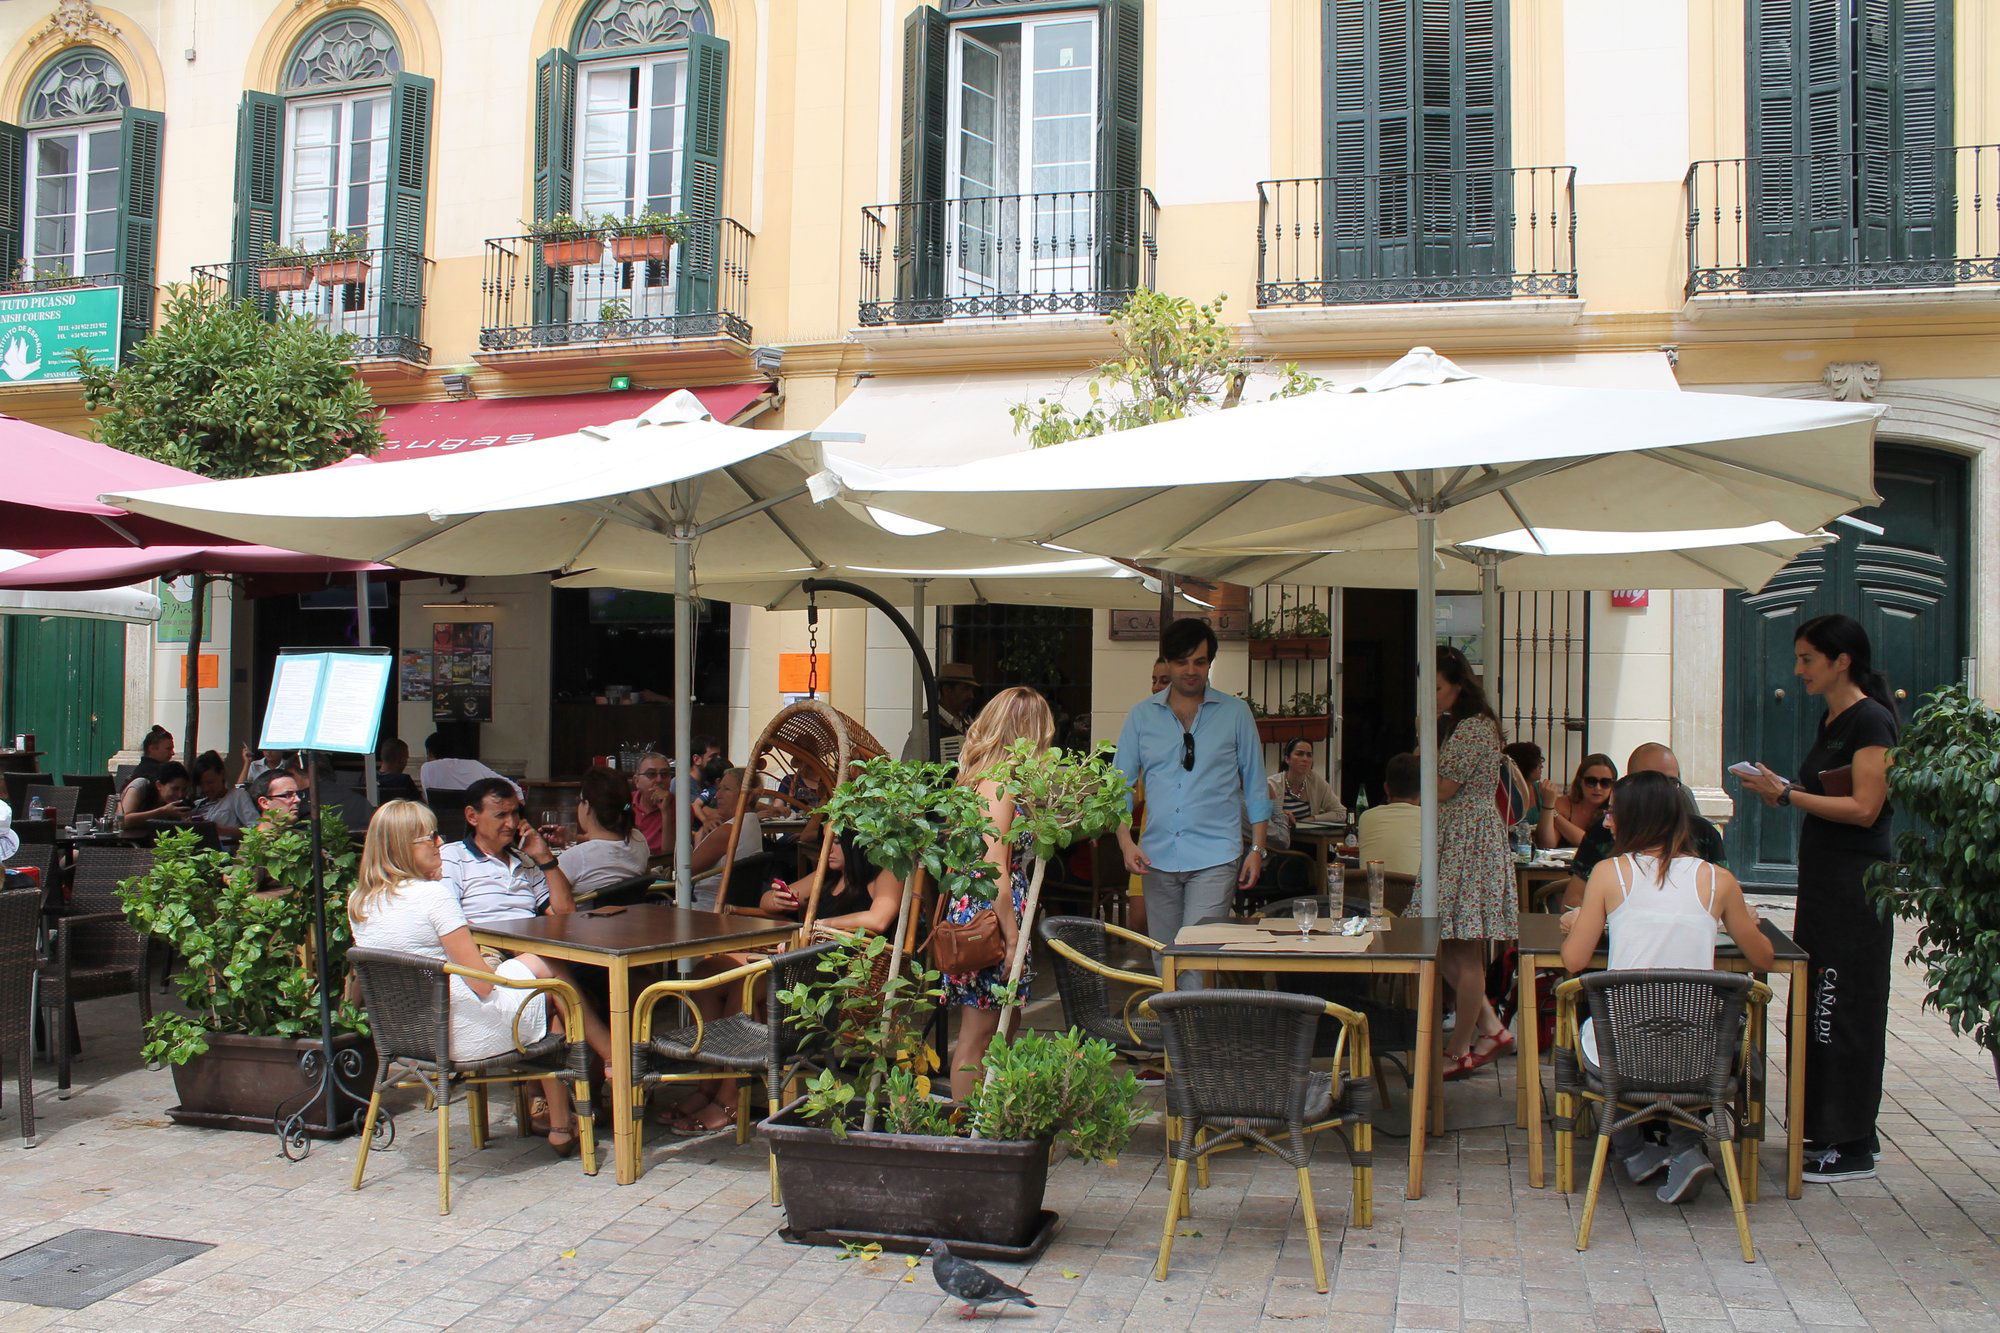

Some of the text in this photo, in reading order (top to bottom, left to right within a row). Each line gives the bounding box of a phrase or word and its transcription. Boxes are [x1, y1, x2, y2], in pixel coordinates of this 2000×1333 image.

[31, 294, 76, 309] PICASSO
[0, 310, 61, 323] NISH COURSES
[43, 371, 66, 379] SPANISH
[1818, 967, 1838, 1044] CAÑADÚ
